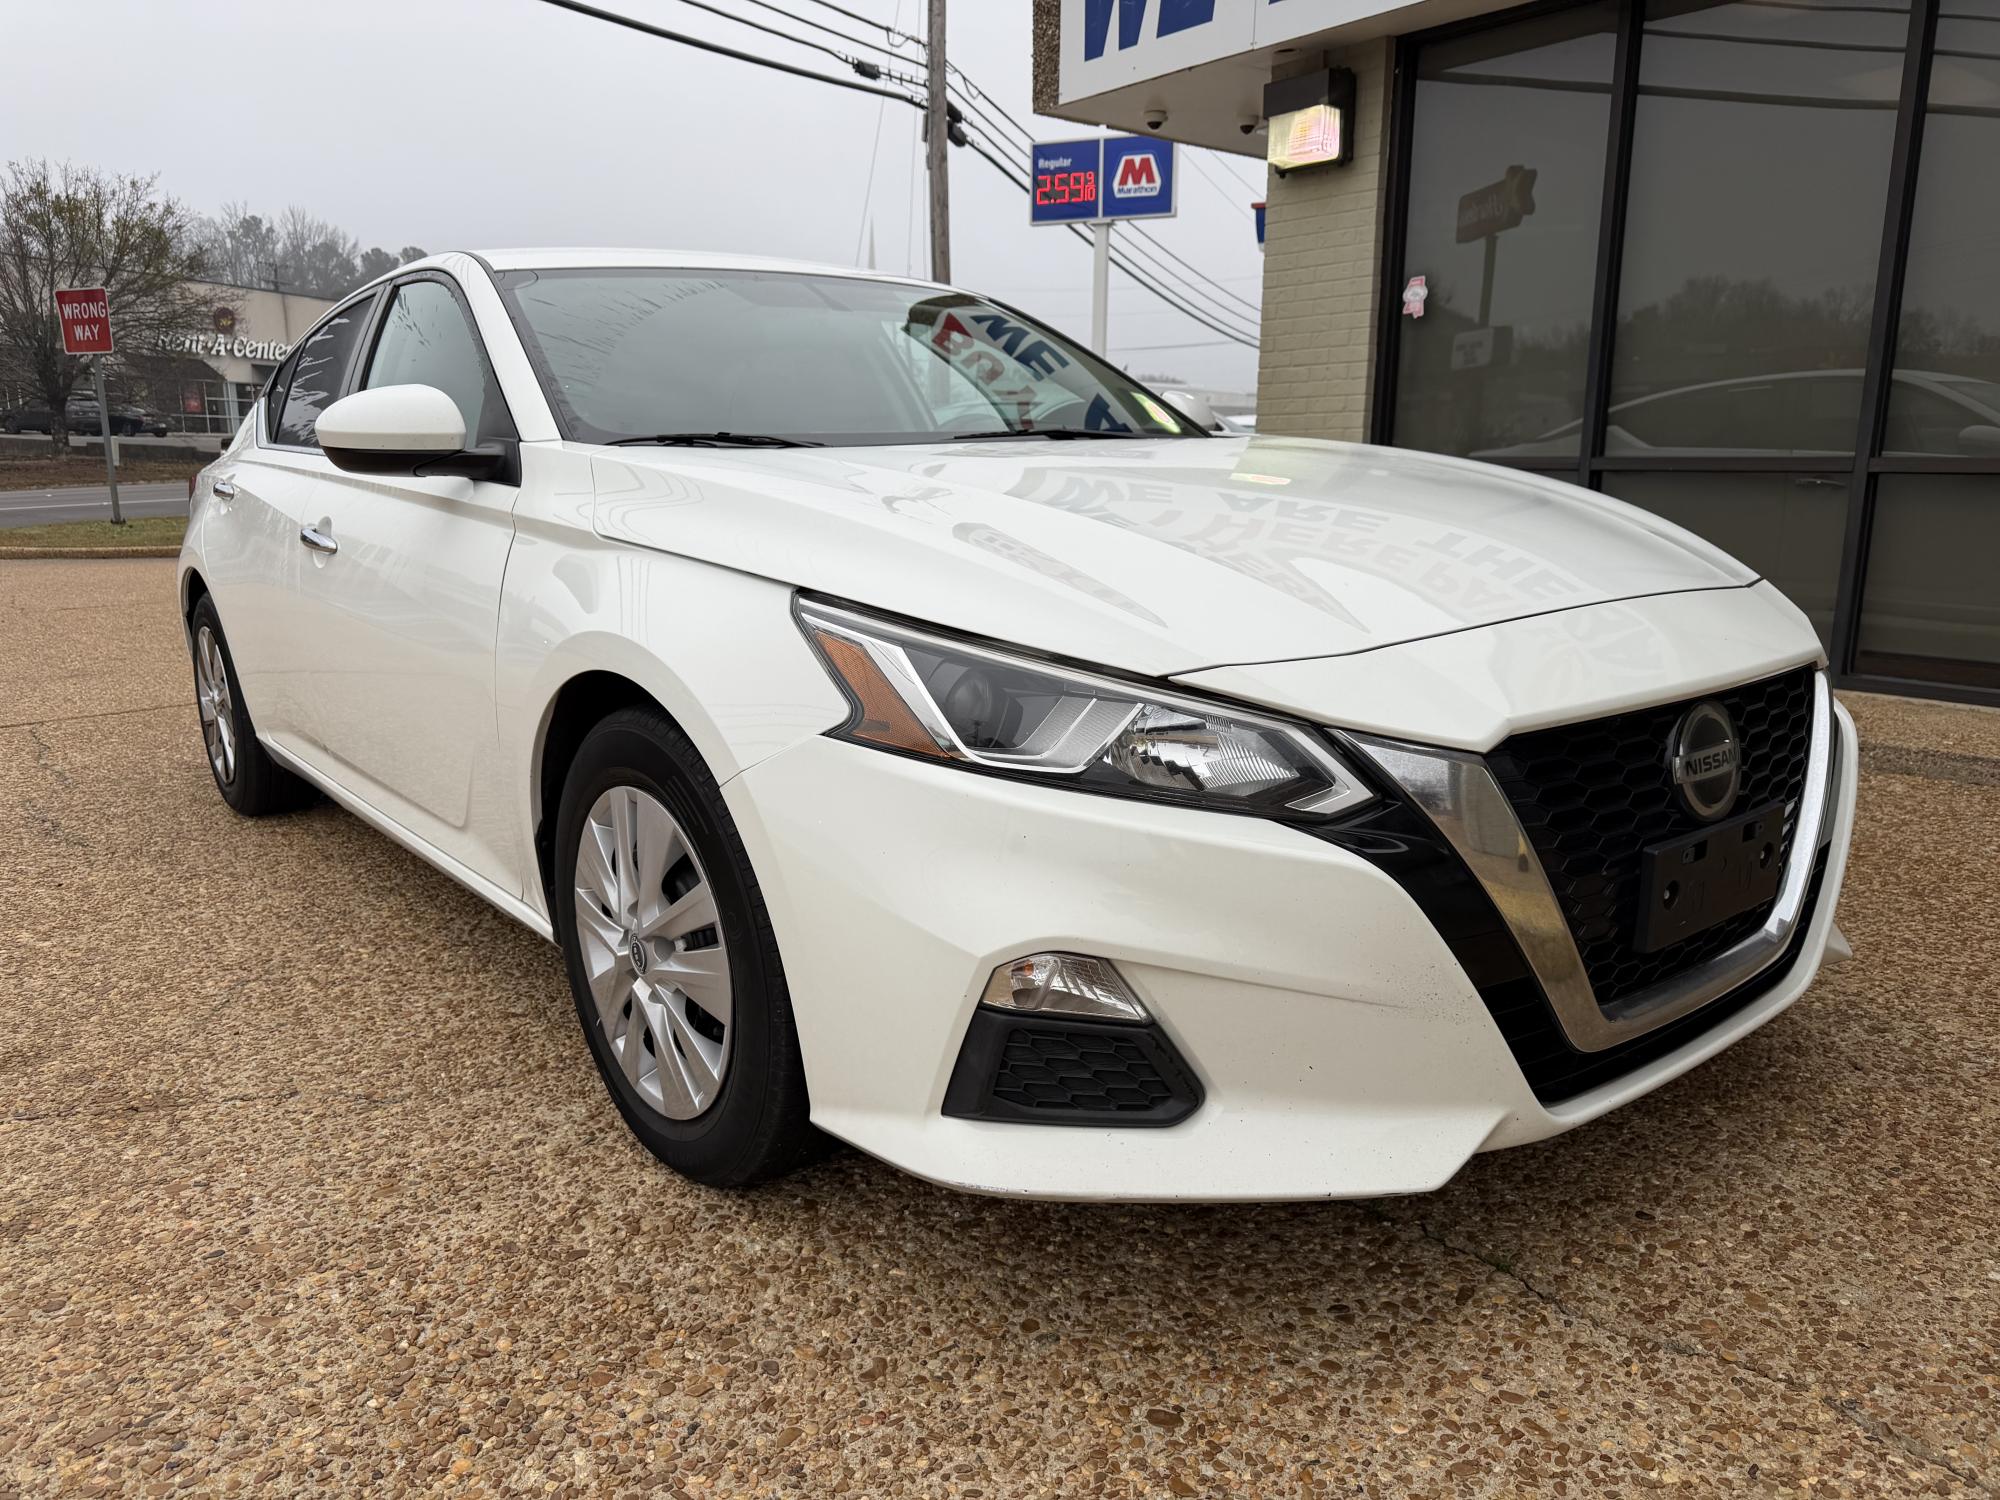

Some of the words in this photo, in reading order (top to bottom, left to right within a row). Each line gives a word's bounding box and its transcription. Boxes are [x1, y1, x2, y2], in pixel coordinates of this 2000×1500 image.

[1038, 157, 1072, 170] Regular
[1117, 186, 1158, 195] Marathon
[62, 301, 106, 320] WRONG
[73, 324, 99, 341] WAY
[1685, 748, 1737, 776] NISSAN
